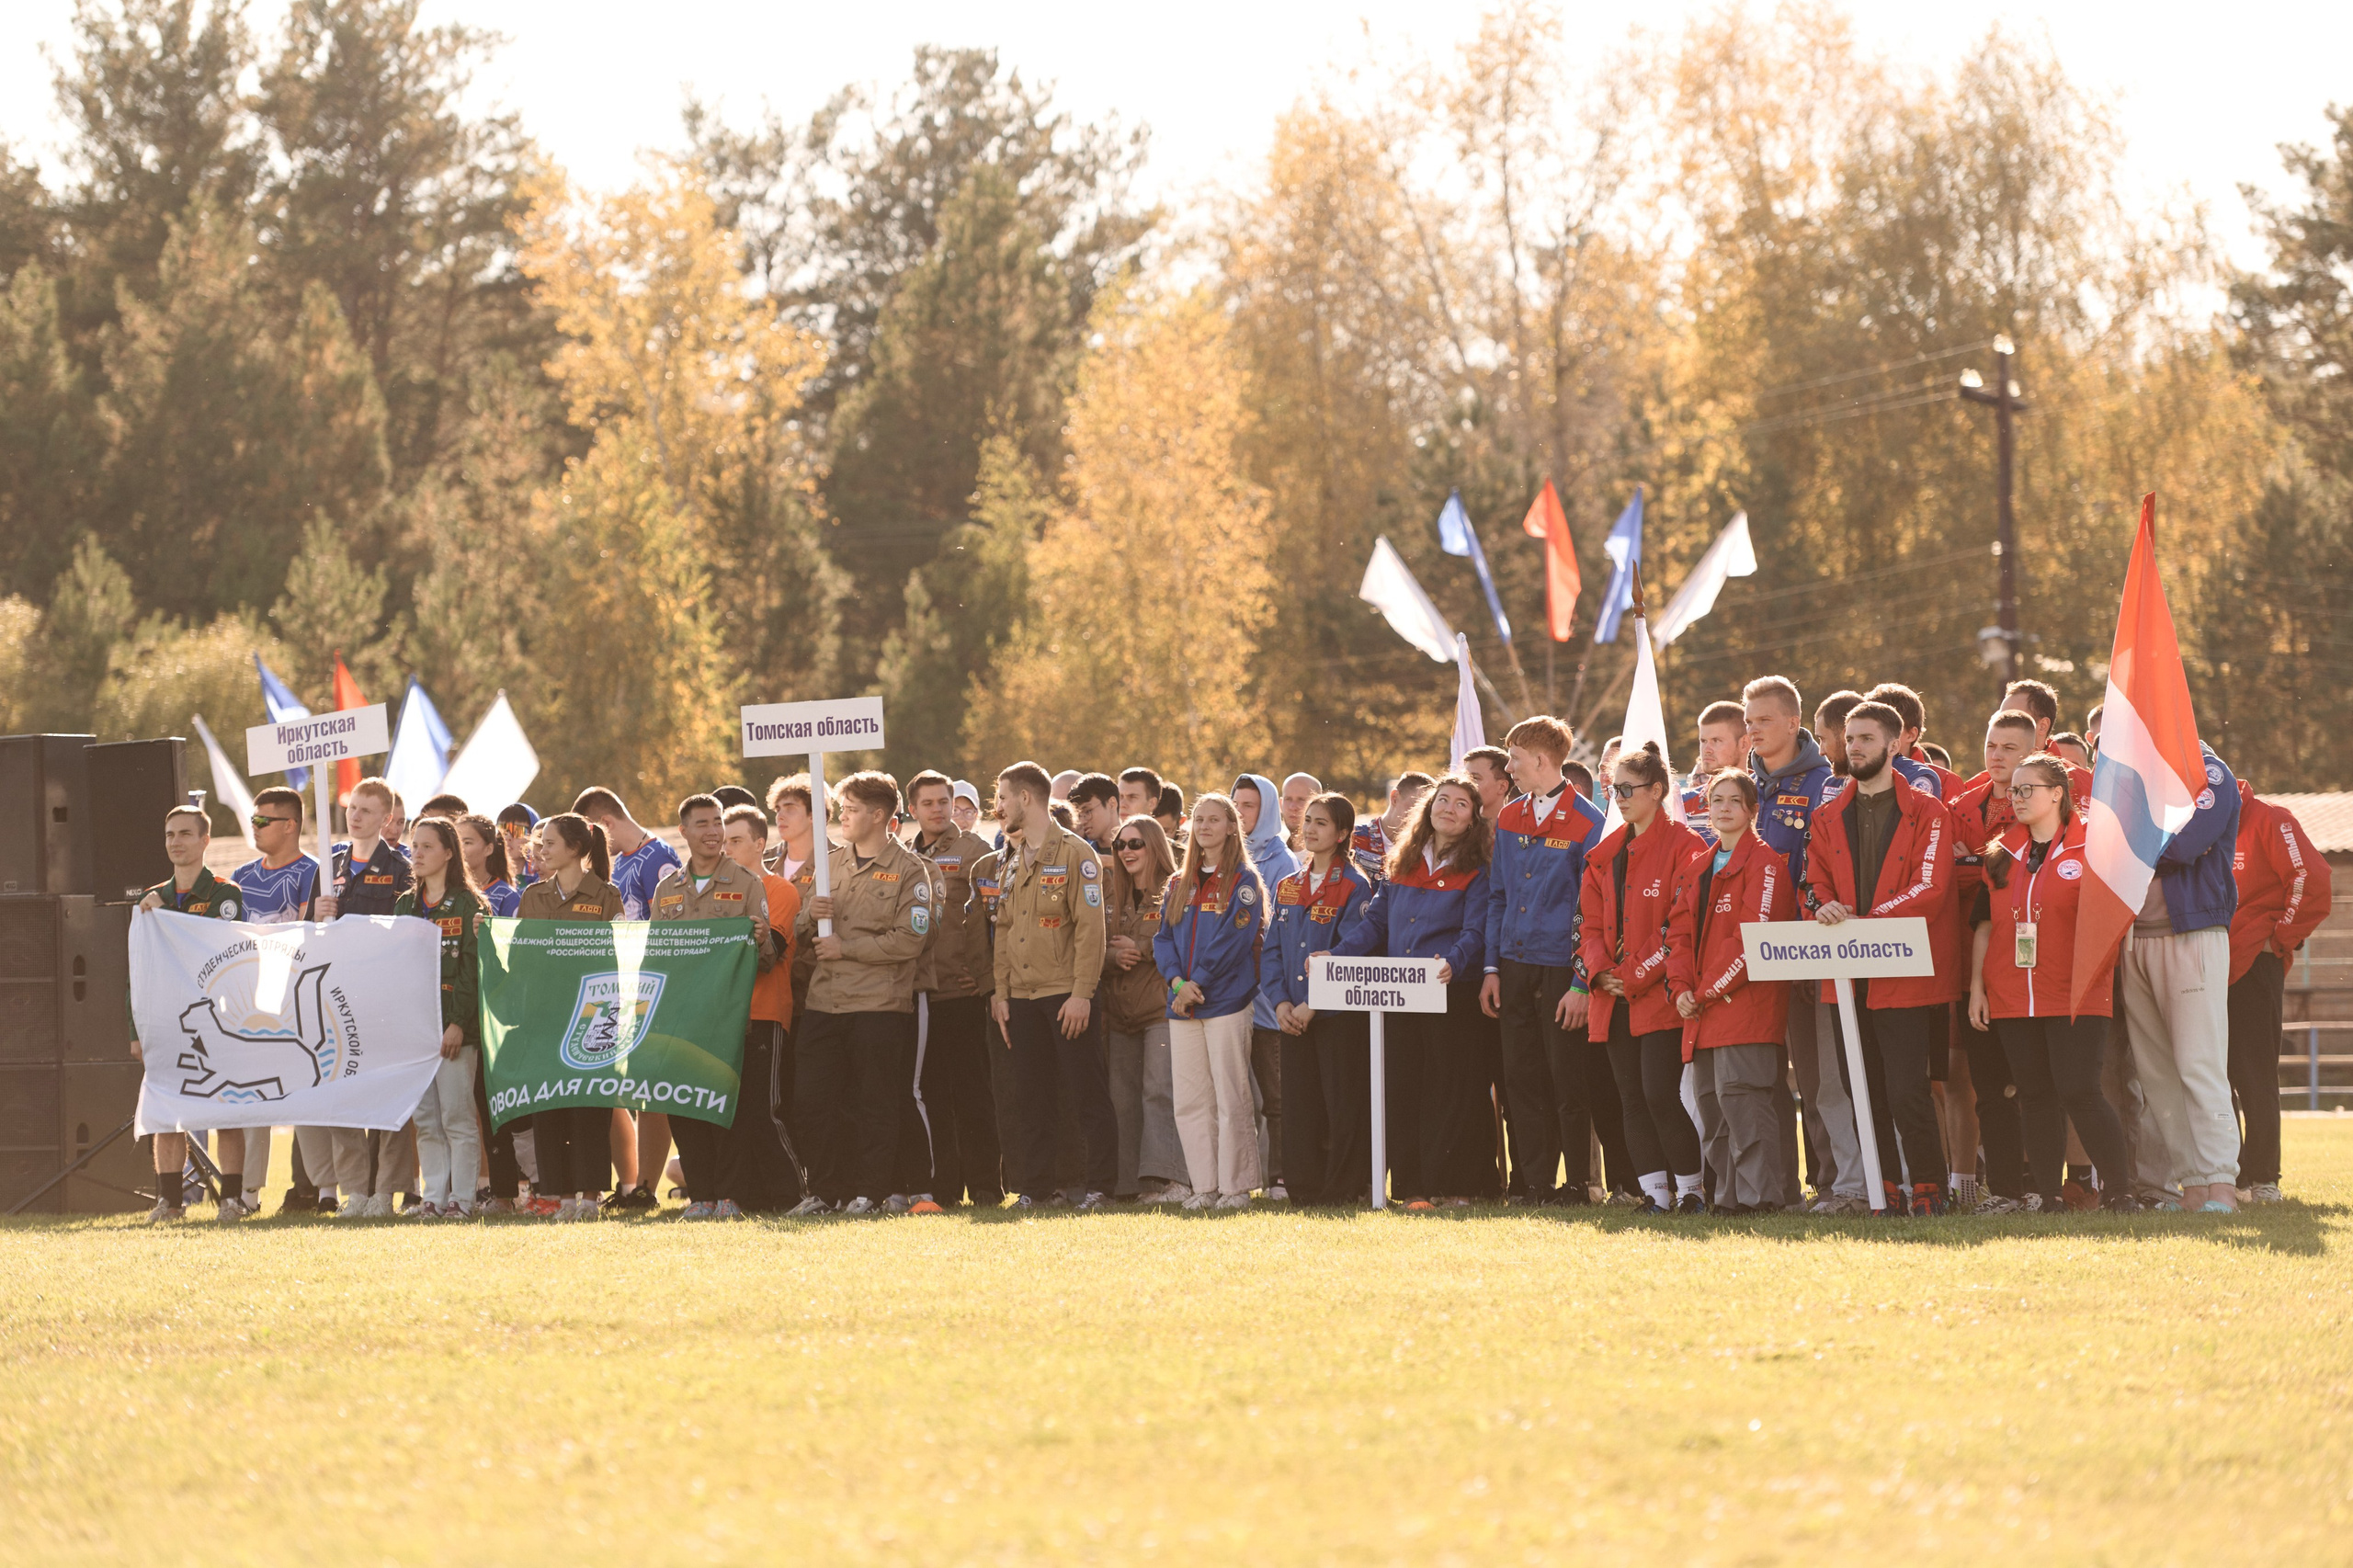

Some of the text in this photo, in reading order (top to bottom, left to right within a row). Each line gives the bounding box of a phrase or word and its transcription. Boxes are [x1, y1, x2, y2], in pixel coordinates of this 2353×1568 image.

[277, 716, 356, 745] Иркутская
[745, 716, 879, 741] Томская область
[287, 740, 348, 764] область
[2283, 832, 2303, 869] ЛУЧШЕЕ
[126, 888, 142, 897] NEXO
[1759, 874, 1776, 915] ЛУЧШЕЕ
[642, 937, 709, 946] БЩЕСТВЕННОЙ
[661, 927, 710, 936] ОТДЕЛЕНИЕ
[546, 948, 606, 957] «РОССИЙСКИЕ
[673, 947, 710, 957] ОТРЯДЫ»
[1759, 941, 1832, 961] Омская
[1837, 938, 1914, 960] область
[1326, 961, 1427, 986] Кемеровская
[1712, 958, 1745, 994] СТРАНЫ
[197, 939, 258, 989] СТУДЕНЧЕСКИЕ
[261, 939, 306, 963] ОТРЯДЫ
[330, 986, 364, 1057] ИРКУТСКОЙ
[1345, 985, 1405, 1006] область
[534, 1077, 583, 1103] ДЛЯ
[585, 1077, 728, 1114] ГОРДОСТИ
